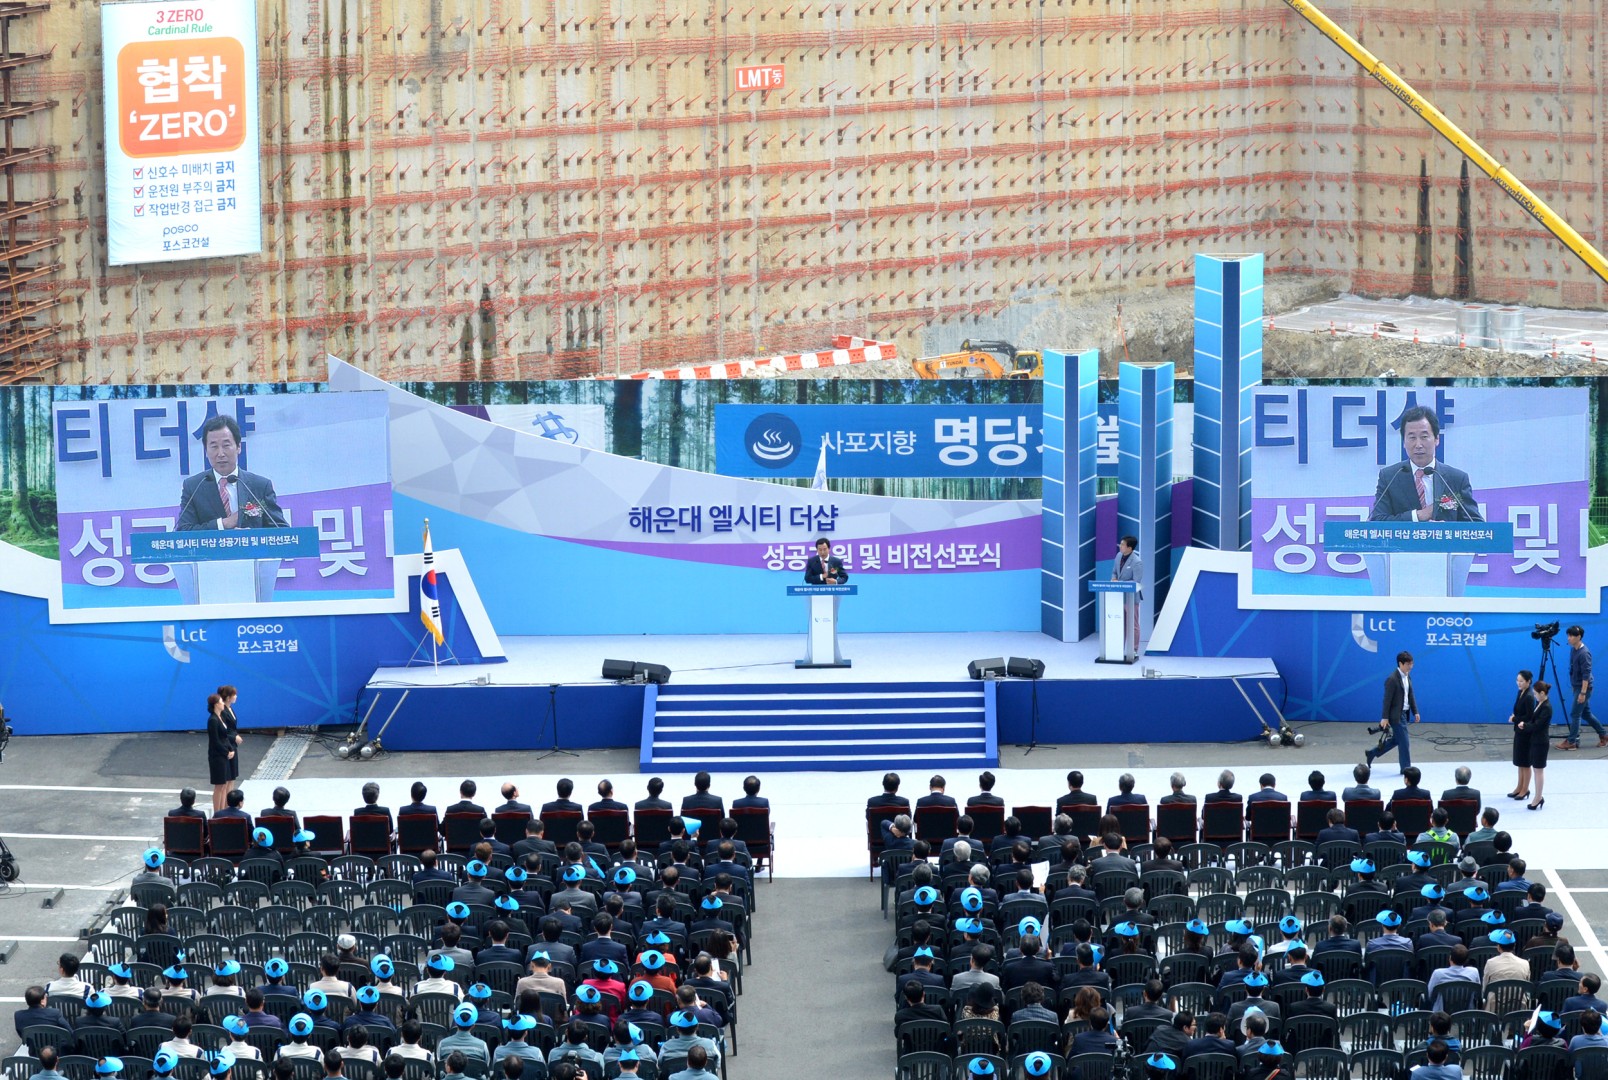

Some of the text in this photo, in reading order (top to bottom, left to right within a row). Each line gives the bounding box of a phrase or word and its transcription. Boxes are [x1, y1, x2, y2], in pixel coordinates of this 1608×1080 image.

[156, 8, 204, 24] 3 ZERO
[147, 23, 213, 36] Cardinal Rule
[136, 55, 227, 104] 협착
[147, 160, 235, 180] 신호수 미배치 금지
[148, 178, 235, 198] 운전원 부주의 금지
[148, 197, 236, 216] 작업반경 접근 금지
[163, 223, 199, 237] posco
[162, 236, 210, 252] 포스코건설
[819, 430, 917, 456] 사포지향
[629, 504, 839, 533] 해운대 엘시티 더샵
[151, 539, 175, 550] 해운대
[201, 538, 217, 548] 더샵
[218, 536, 250, 548] 성공기원
[260, 535, 299, 546] 비전선포식
[311, 505, 369, 579] 및
[1344, 529, 1368, 539] 해운대
[1369, 529, 1393, 539] 엘시티
[1395, 529, 1410, 539] 더샵
[1412, 529, 1443, 540] 성공기원
[1454, 529, 1493, 540] 비전선포식
[1508, 503, 1563, 575] 및
[762, 542, 1001, 571] 성공원 및 비전선포식
[237, 624, 283, 638] posco
[1426, 617, 1473, 630] posco
[237, 639, 299, 654] 포스코건설
[1425, 633, 1487, 647] 포스코건설
